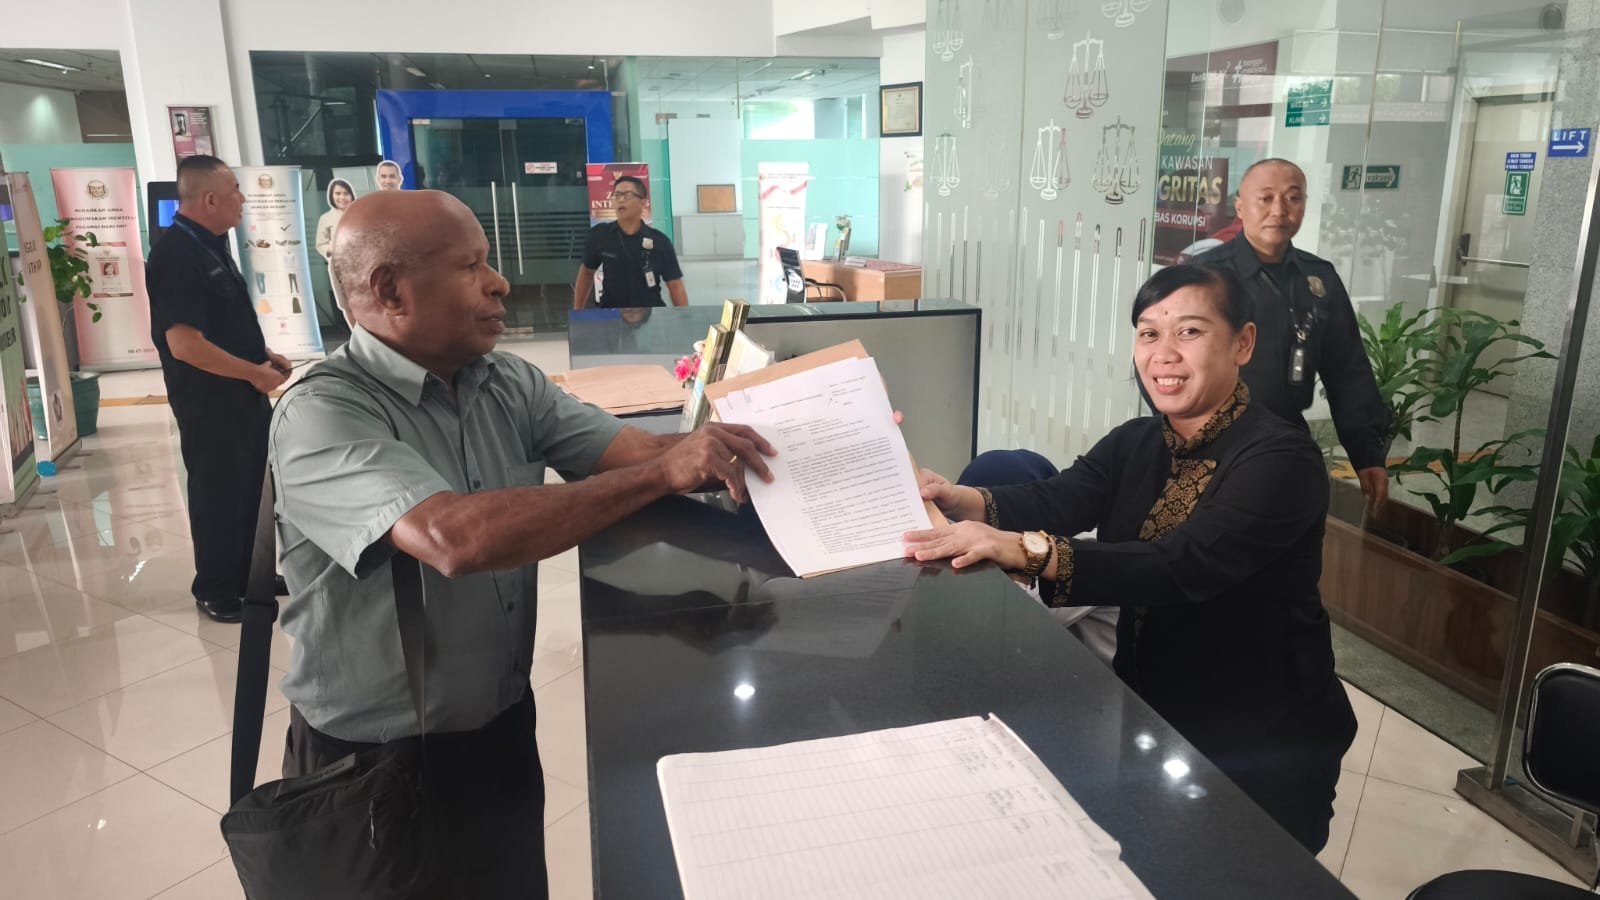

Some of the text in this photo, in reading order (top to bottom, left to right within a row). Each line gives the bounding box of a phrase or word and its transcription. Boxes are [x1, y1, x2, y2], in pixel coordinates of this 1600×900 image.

[1552, 131, 1587, 142] LIFT
[1161, 155, 1213, 170] KAWASAN
[1158, 174, 1222, 205] GRITAS
[1171, 213, 1206, 227] KORUPSI
